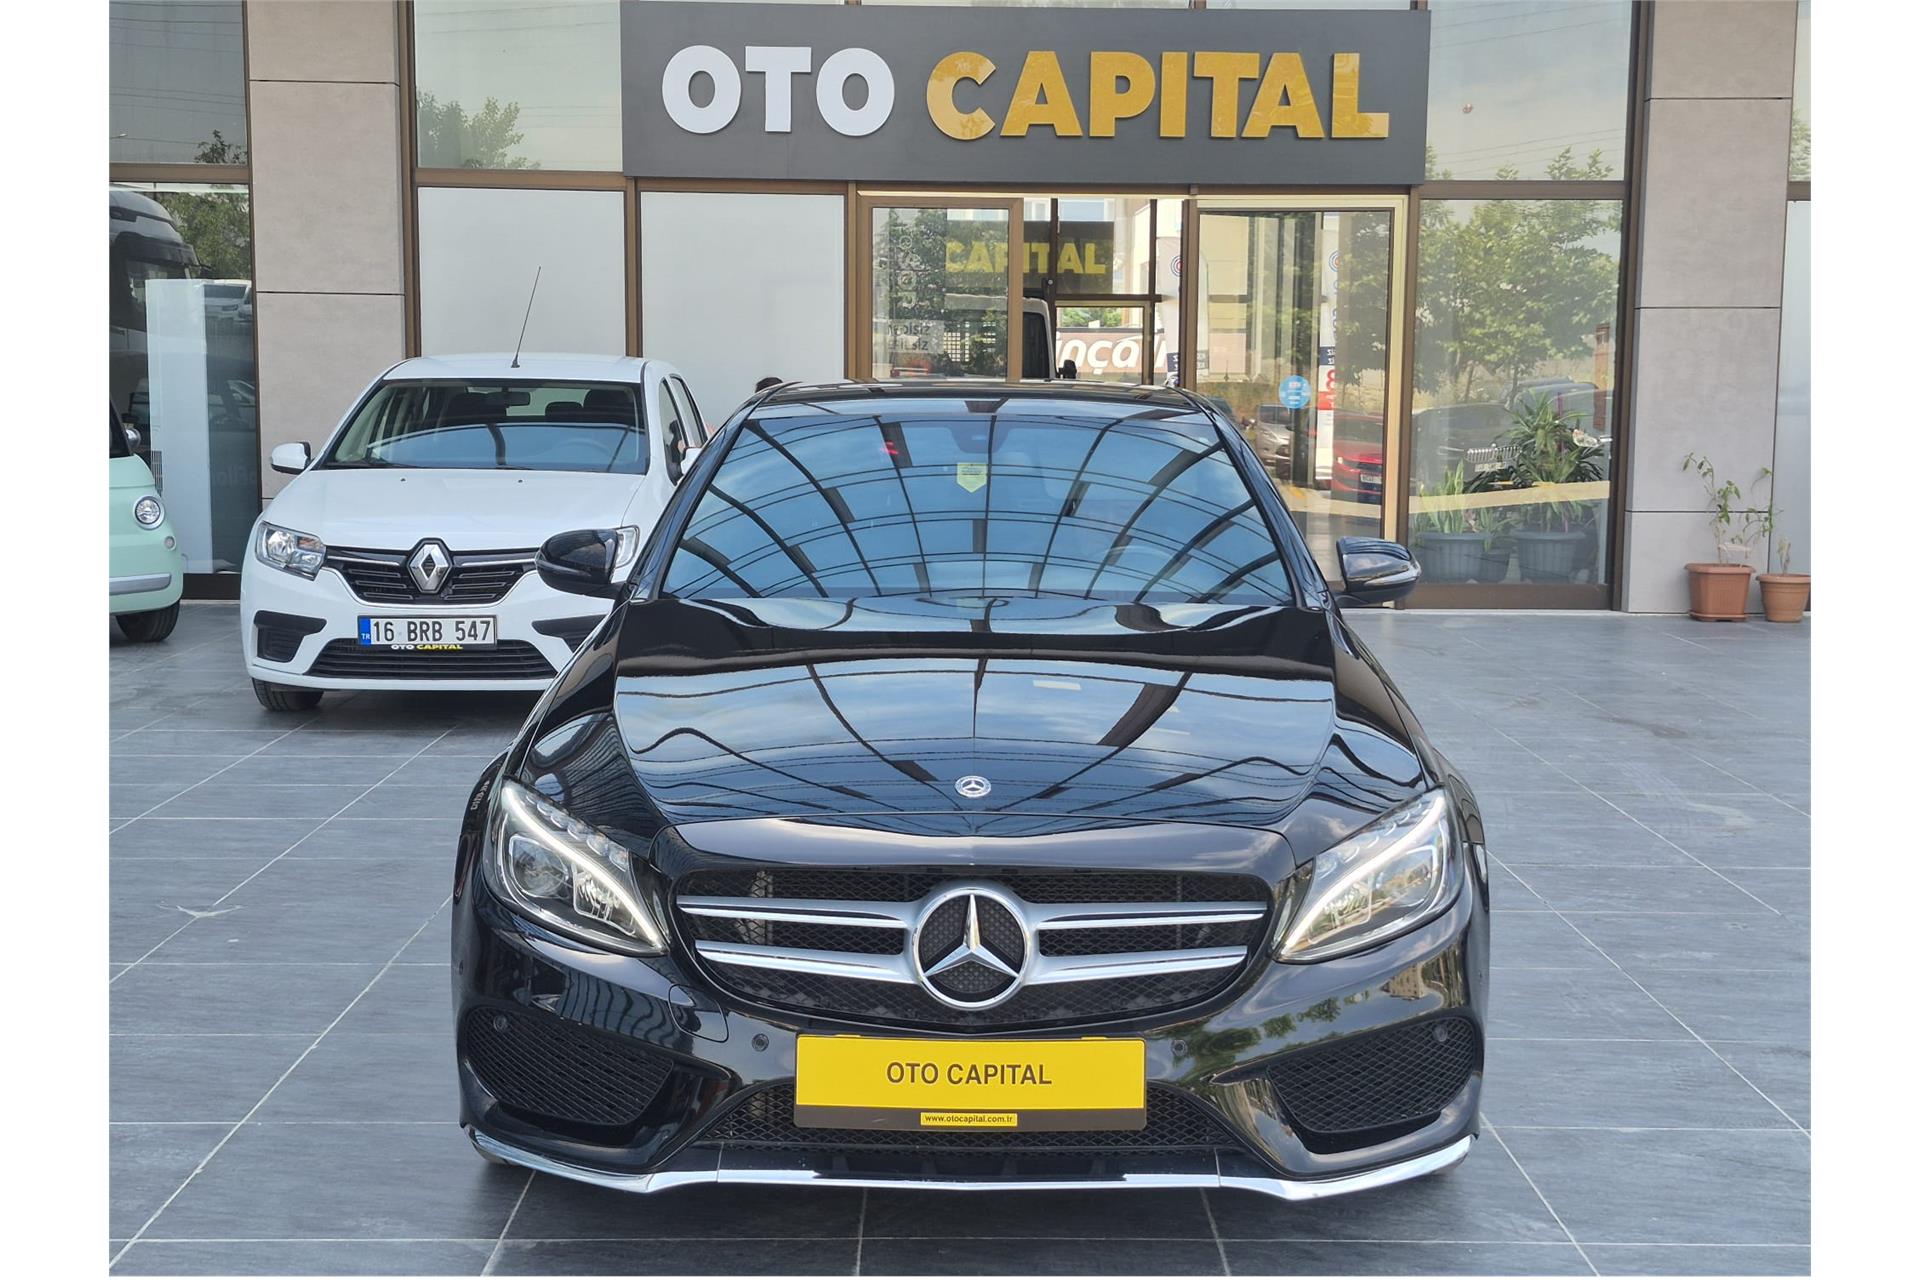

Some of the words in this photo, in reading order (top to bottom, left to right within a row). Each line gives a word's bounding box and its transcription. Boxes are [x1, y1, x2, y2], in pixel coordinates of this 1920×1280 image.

[661, 45, 895, 137] OTO
[926, 50, 1390, 141] CAPITAL
[373, 620, 395, 642] 16
[407, 620, 443, 642] BRB
[455, 619, 491, 641] 547
[886, 1061, 940, 1084] OTO
[946, 1063, 1053, 1086] CAPITAL
[924, 1114, 1014, 1125] www.otocapital.com.tr
